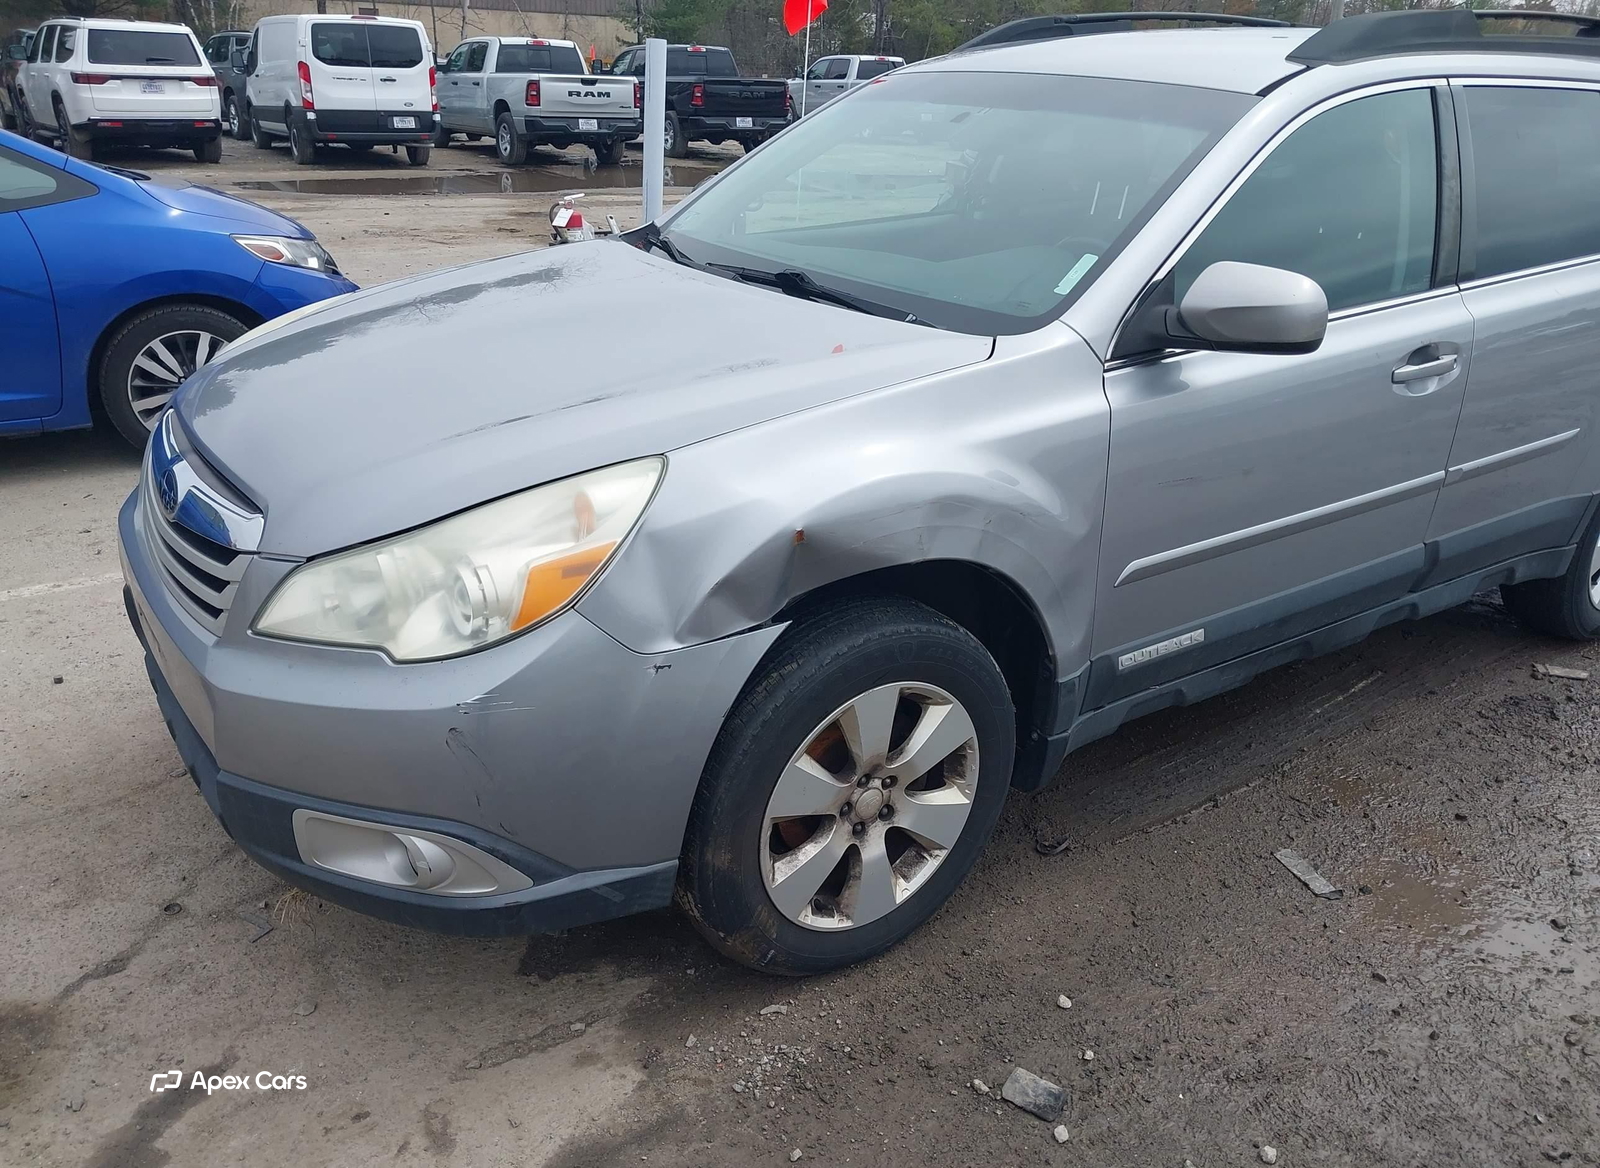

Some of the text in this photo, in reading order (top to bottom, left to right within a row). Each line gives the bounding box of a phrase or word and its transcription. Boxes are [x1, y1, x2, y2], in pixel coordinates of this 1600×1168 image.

[567, 90, 611, 98] RAM
[727, 91, 766, 99] RAM
[1120, 629, 1204, 668] OUTBACK
